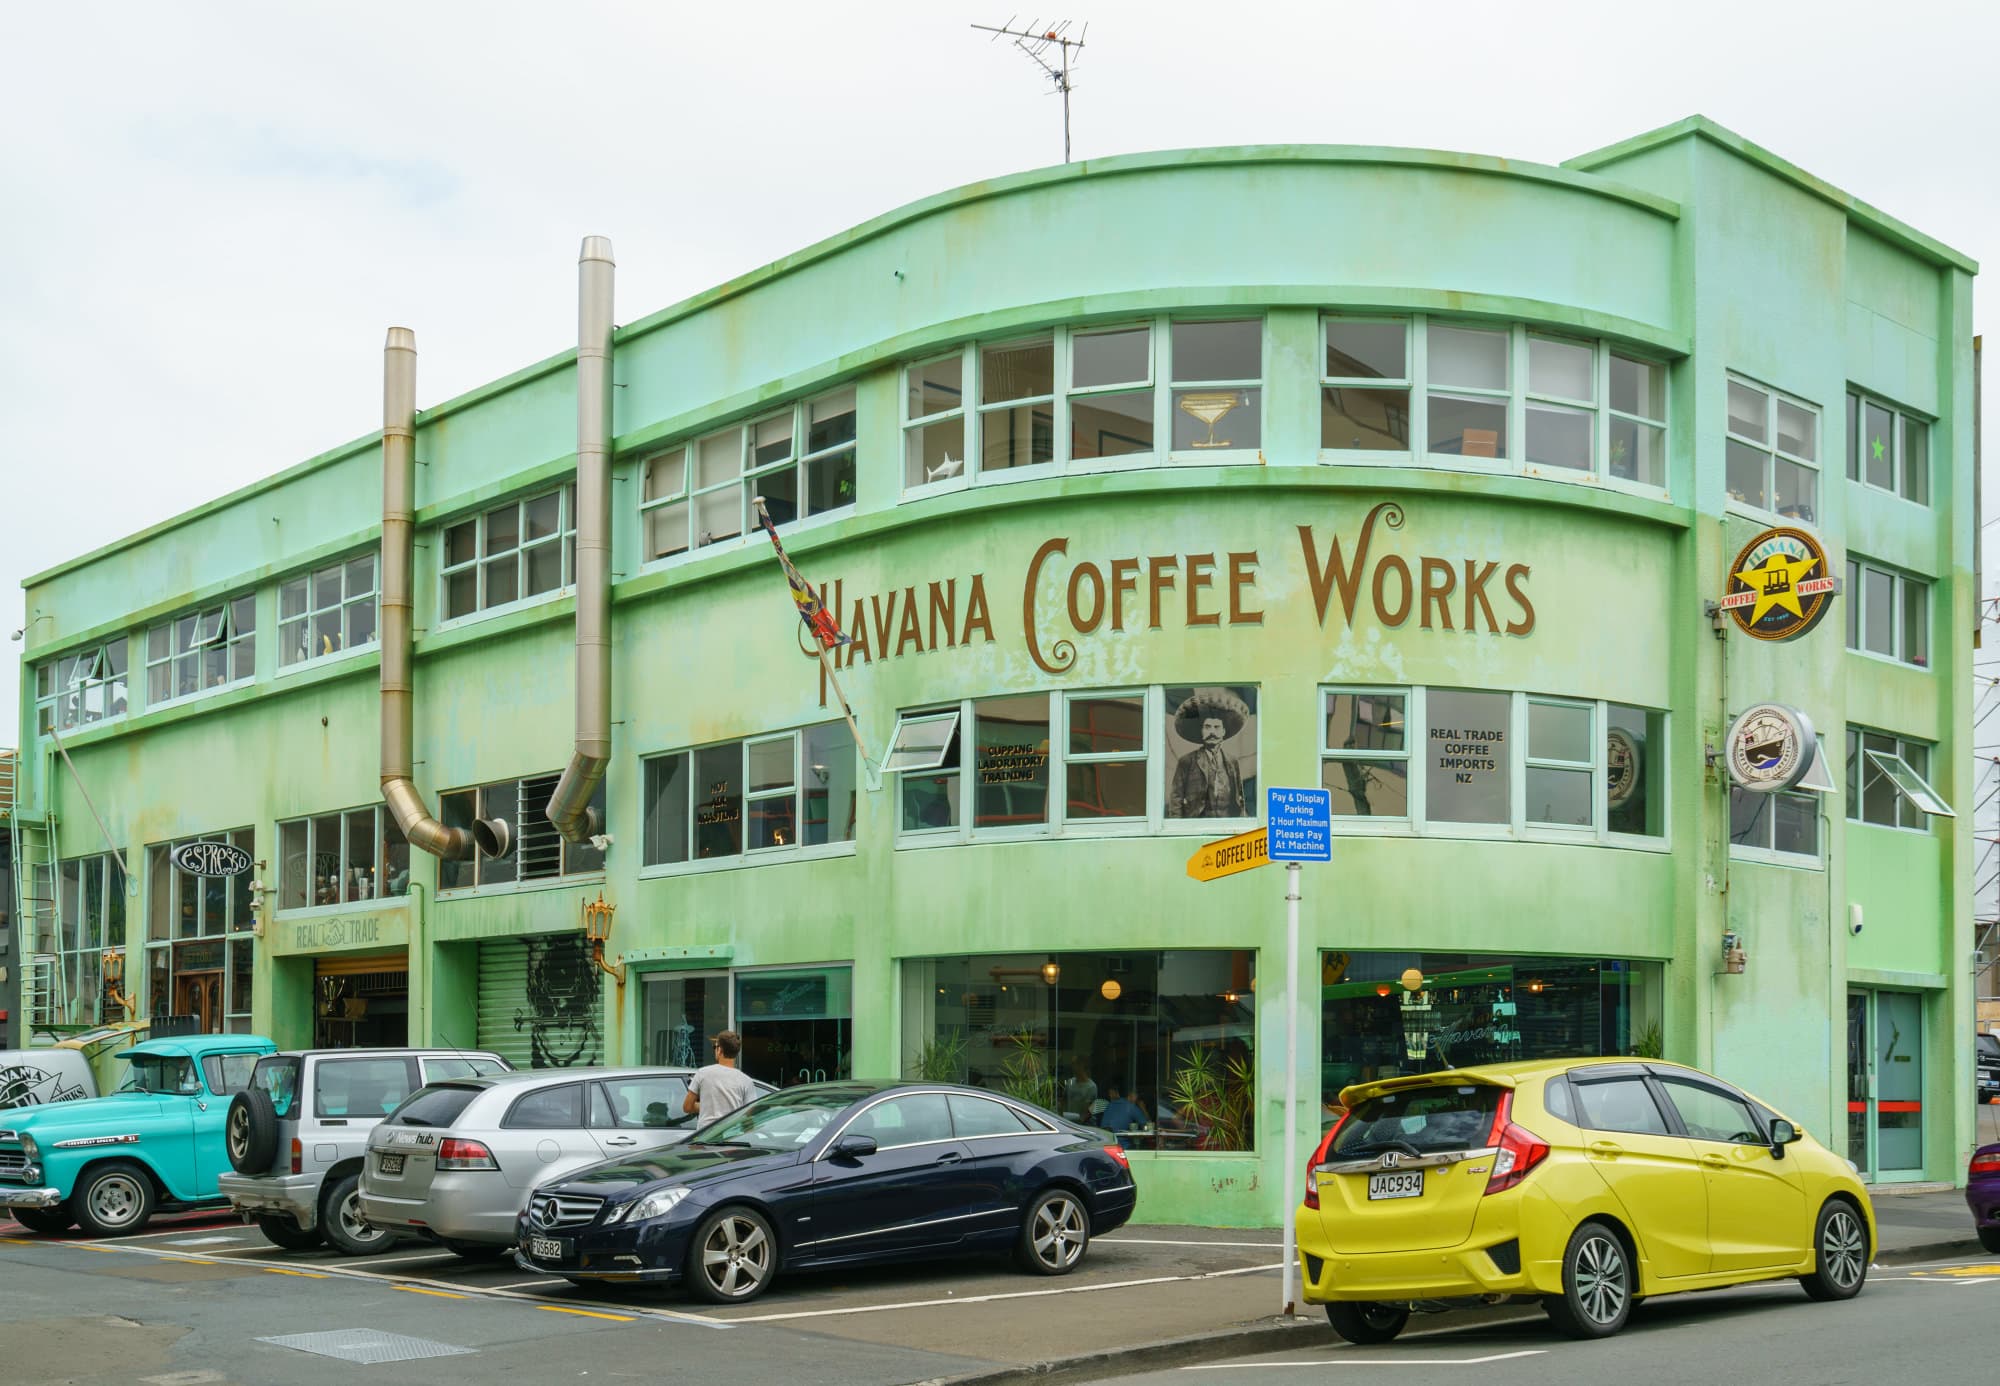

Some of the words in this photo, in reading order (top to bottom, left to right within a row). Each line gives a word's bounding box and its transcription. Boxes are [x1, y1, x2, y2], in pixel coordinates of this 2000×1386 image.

[1748, 542, 1806, 568] HAVANA
[1721, 592, 1756, 608] COFFEE
[1797, 577, 1833, 595] WORKS
[797, 573, 996, 708] HAVANA
[1024, 537, 1266, 675] COFFEE
[1296, 502, 1537, 637] WORKS
[1430, 728, 1461, 740] REAL
[1463, 729, 1504, 742] TRADE
[988, 744, 1034, 757] CUPPING
[1444, 743, 1490, 756] COFFEE
[978, 756, 1045, 771] LABORATORY
[1439, 757, 1496, 771] IMPORTS
[983, 770, 1034, 784] TRAINING
[1455, 773, 1473, 784] NZ
[1271, 791, 1286, 804] Pay
[1288, 792, 1294, 802] &
[1296, 792, 1325, 806] Display
[1284, 804, 1314, 816] Parking
[1270, 817, 1275, 826] 2
[1277, 817, 1294, 826] Hour
[1296, 817, 1328, 827] Maximum
[1275, 828, 1305, 839] Please
[1307, 830, 1323, 841] Pay
[1275, 840, 1286, 849] At
[1288, 841, 1325, 851] Machine
[1215, 842, 1246, 869] COFFEE
[1246, 842, 1253, 860] U
[296, 924, 321, 949] REAL
[350, 918, 379, 944] TRADE
[1371, 1174, 1421, 1194] JAC934
